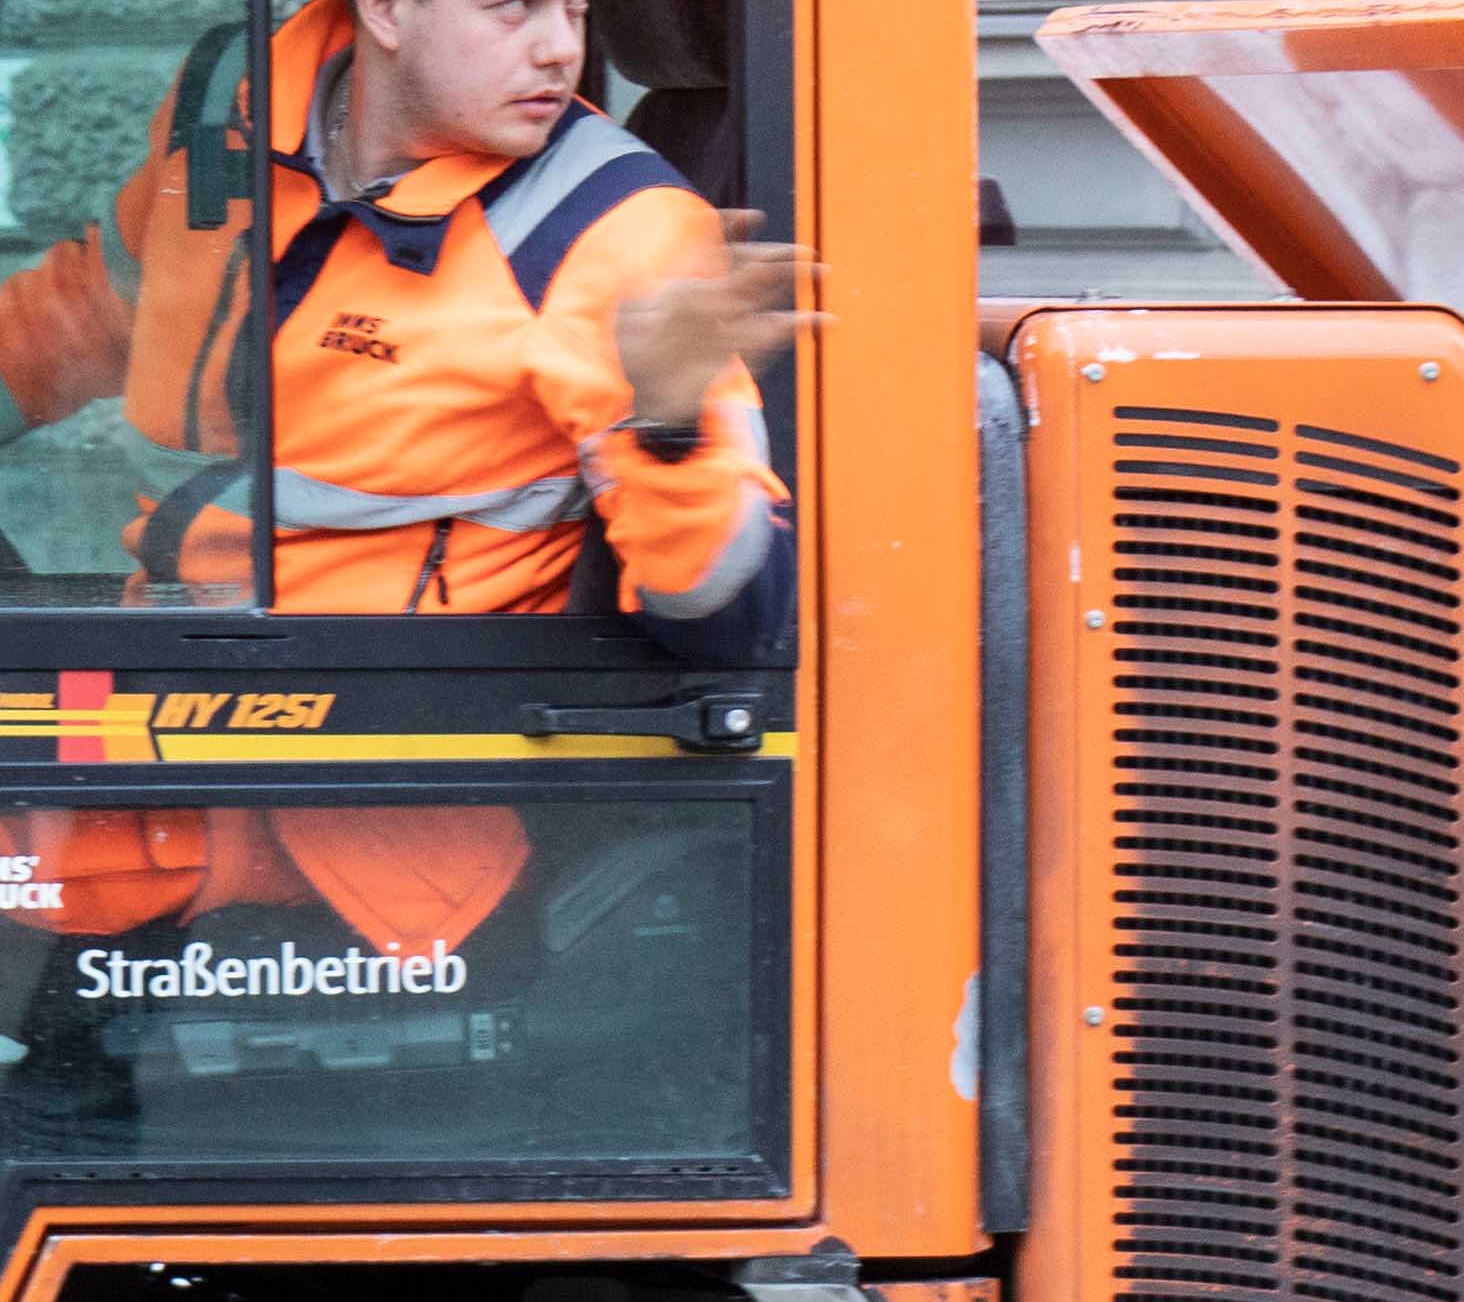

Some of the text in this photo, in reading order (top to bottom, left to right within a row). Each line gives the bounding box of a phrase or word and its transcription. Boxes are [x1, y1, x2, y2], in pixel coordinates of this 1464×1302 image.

[319, 331, 400, 364] BRUCK
[152, 693, 336, 729] HY 1251
[76, 940, 467, 998] Straßenbetrieb
